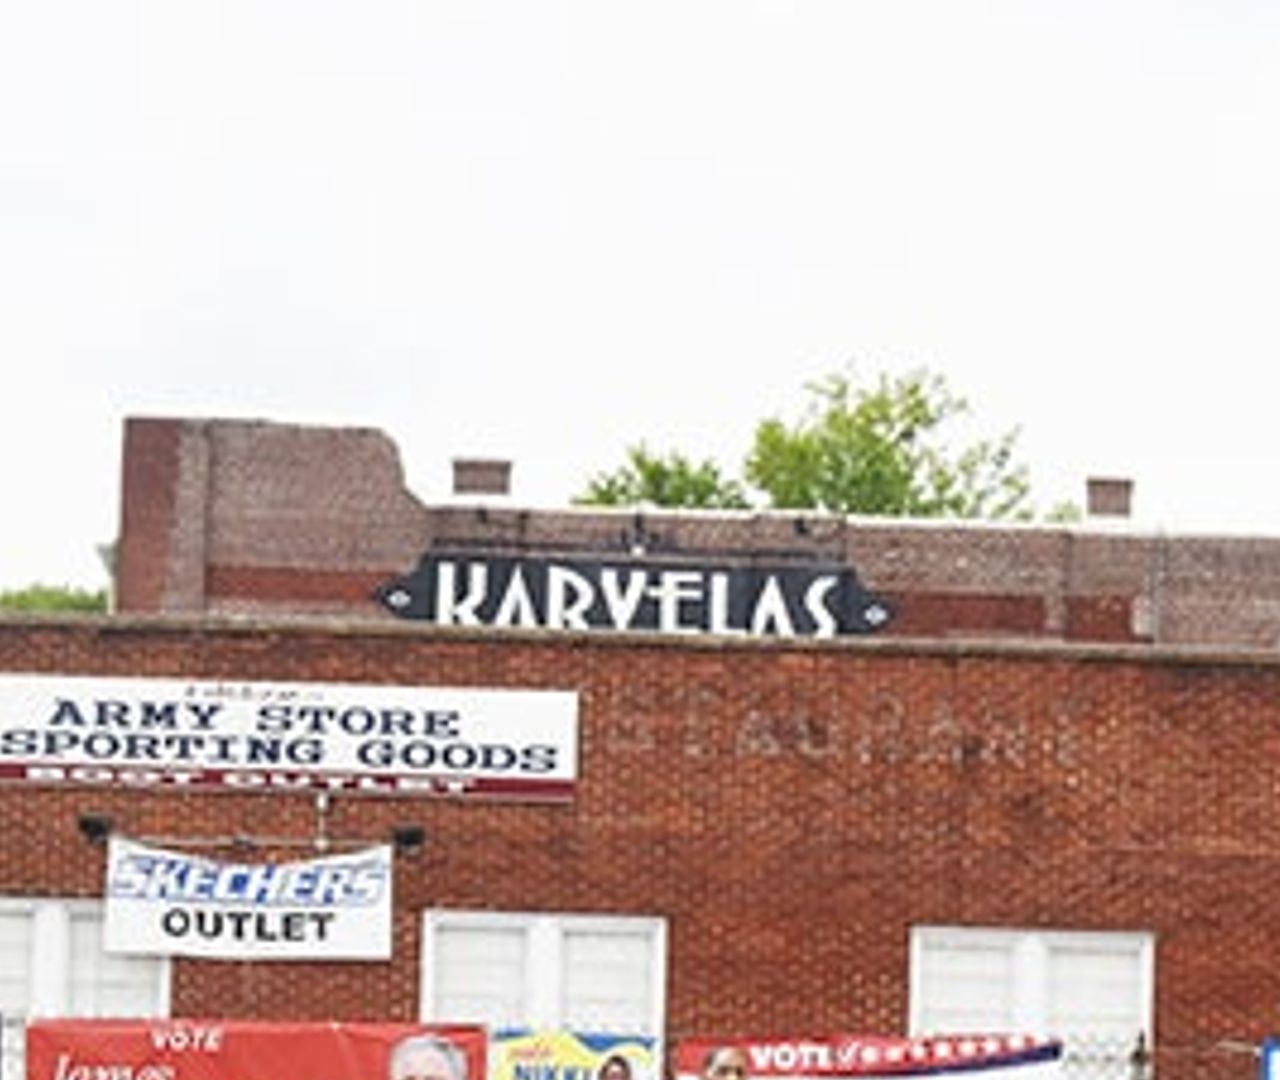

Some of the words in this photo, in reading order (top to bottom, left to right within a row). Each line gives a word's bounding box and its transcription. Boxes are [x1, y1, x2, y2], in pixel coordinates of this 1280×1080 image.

[436, 561, 838, 638] KARVELAS
[49, 699, 222, 730] ARMY
[256, 705, 461, 738] STORE
[0, 730, 325, 764] SPORTING
[356, 740, 557, 773] GOODS
[112, 857, 386, 902] SKECHERS
[162, 908, 334, 941] OUTLET
[151, 1029, 220, 1052] VOTE
[749, 1043, 835, 1070] VOTE
